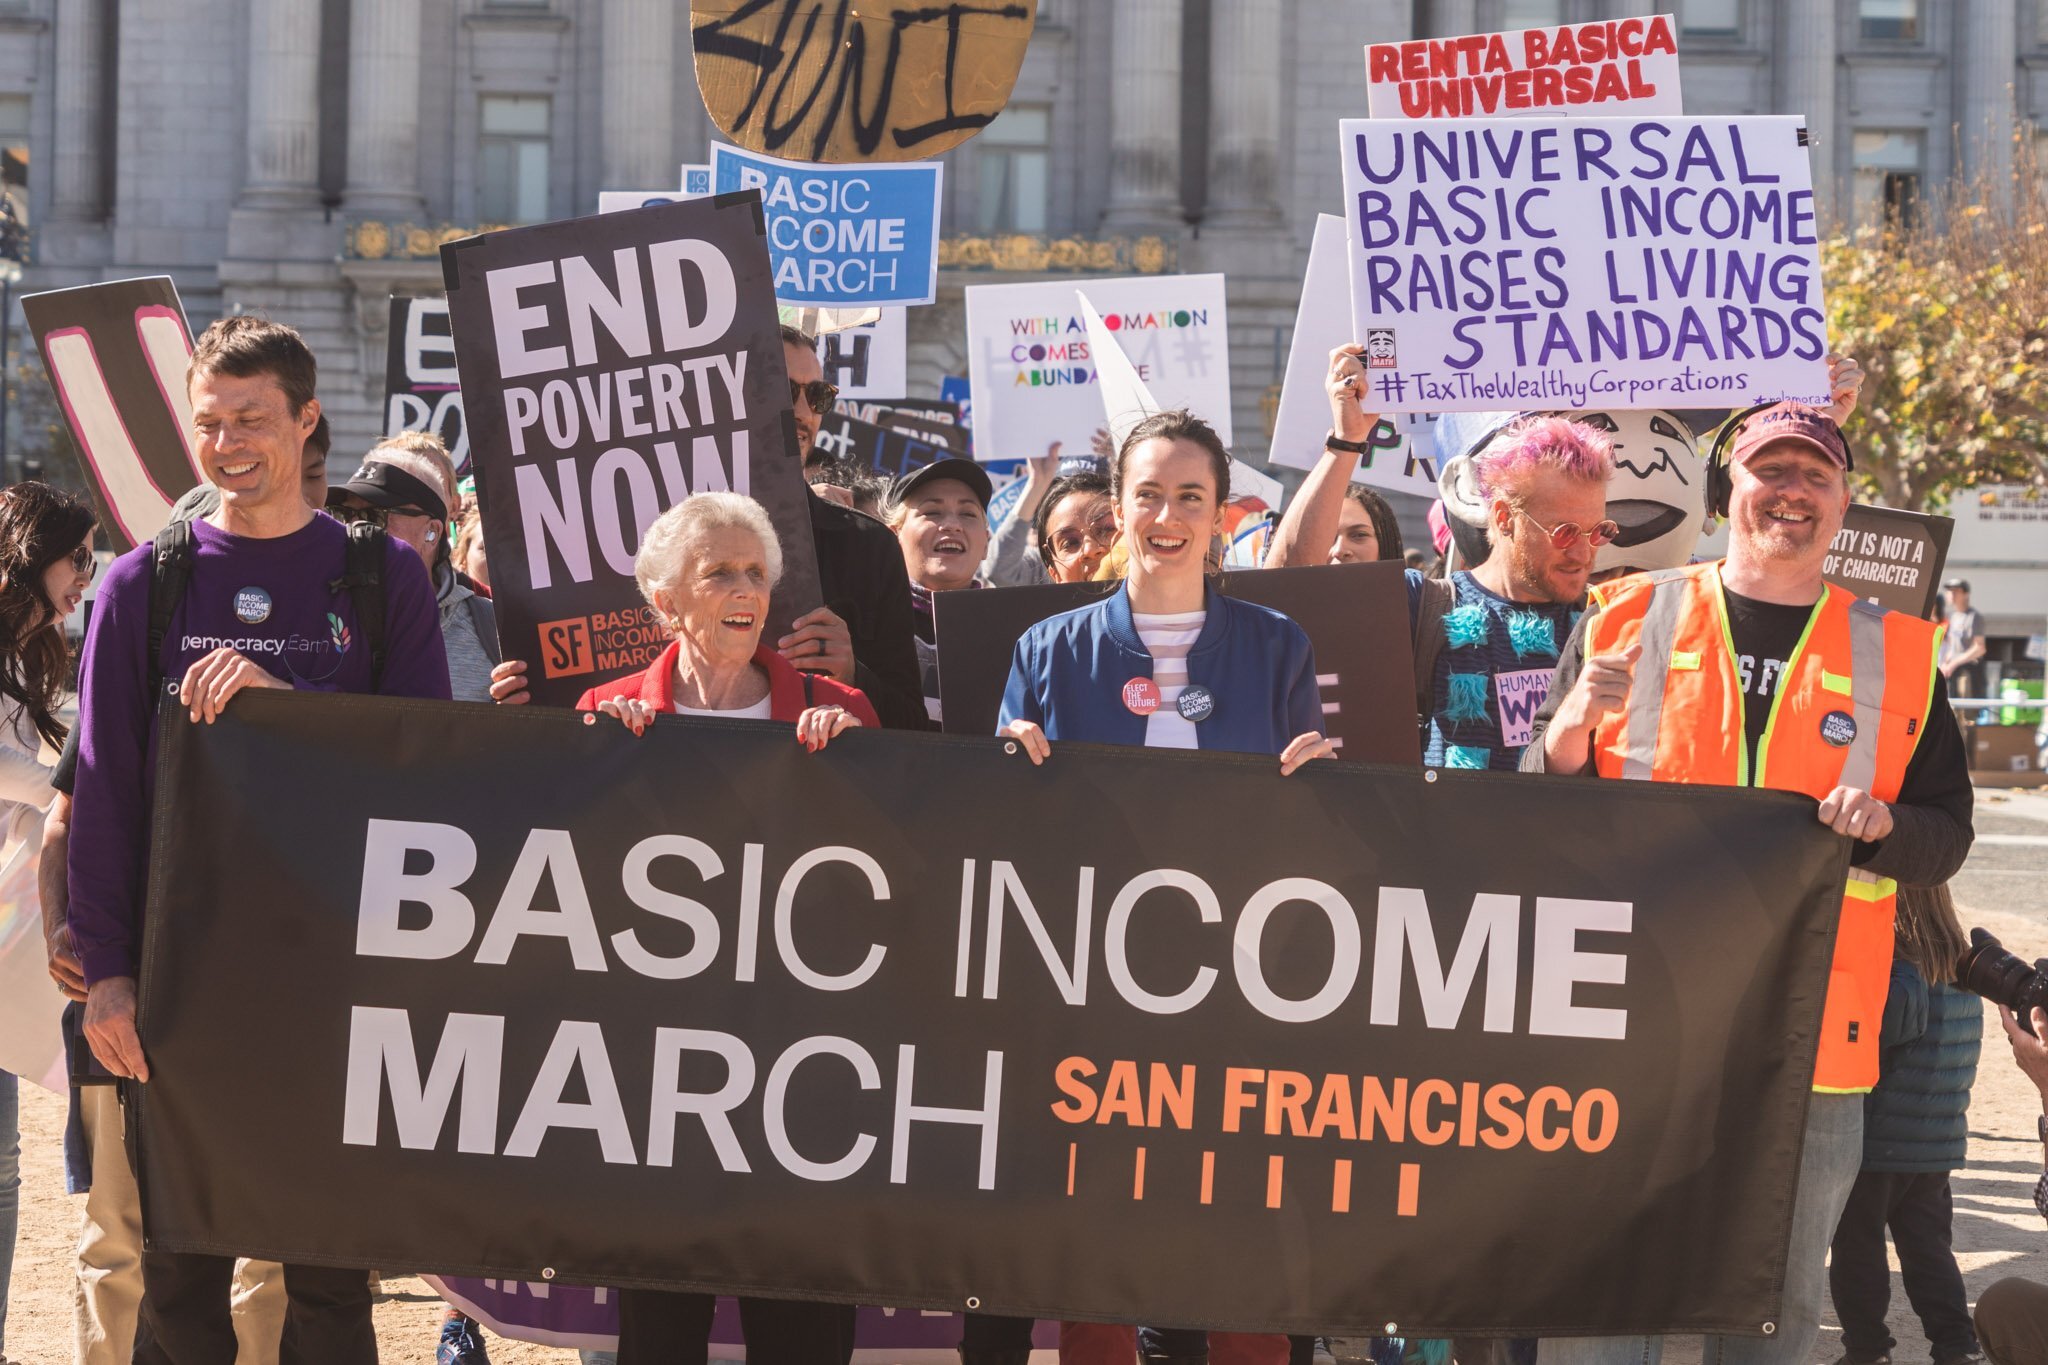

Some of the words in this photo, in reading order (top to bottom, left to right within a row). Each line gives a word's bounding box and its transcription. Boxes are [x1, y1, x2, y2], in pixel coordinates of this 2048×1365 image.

[1369, 34, 1513, 83] RENTA
[1524, 16, 1678, 69] BASICA
[1398, 59, 1656, 118] UNIVERSAL
[1356, 122, 1780, 185] UNIVERSAL
[741, 166, 871, 214] BASIC
[1358, 185, 1557, 249] BASIC
[1601, 185, 1817, 245] INCOME
[765, 212, 905, 253] COME
[770, 254, 897, 293] ARCH
[1367, 247, 1568, 314] RAISES
[1605, 248, 1810, 305] LIVING
[486, 238, 737, 379] END
[1011, 318, 1057, 336] WITH
[1066, 310, 1207, 334] AOMATION
[1443, 305, 1824, 369] STANDARDS
[1011, 343, 1089, 363] COMES
[1372, 357, 1394, 366] MATH
[504, 350, 748, 456] POVERTY
[1060, 460, 1097, 471] MATH
[1860, 532, 1878, 556] IS
[1879, 535, 1912, 561] NOT
[1912, 541, 1924, 563] A
[1822, 555, 1842, 575] OF
[1843, 557, 1919, 587] CHARACTER
[239, 593, 263, 602] BASIC
[239, 600, 269, 610] INCOME
[237, 608, 268, 617] MARCH
[592, 606, 655, 632] BASIC
[547, 623, 583, 670] SF
[593, 624, 673, 650] INCOM
[597, 645, 663, 671] MARC
[1126, 683, 1148, 692] ELECT
[1127, 691, 1142, 700] THE
[1179, 690, 1203, 704] BASIC
[1128, 698, 1156, 708] FUTURE
[1181, 695, 1211, 710] INCOME
[1184, 702, 1212, 717] MARCH
[1826, 721, 1855, 737] INCOME
[1828, 714, 1851, 728] BASIC
[1824, 728, 1851, 744] MARCH
[356, 819, 890, 991] BASIC
[955, 859, 1633, 1040] INCOME
[343, 1006, 1003, 1190] MARCH
[1051, 1056, 1196, 1129] SAN
[1223, 1067, 1619, 1153] FRANCISCO
